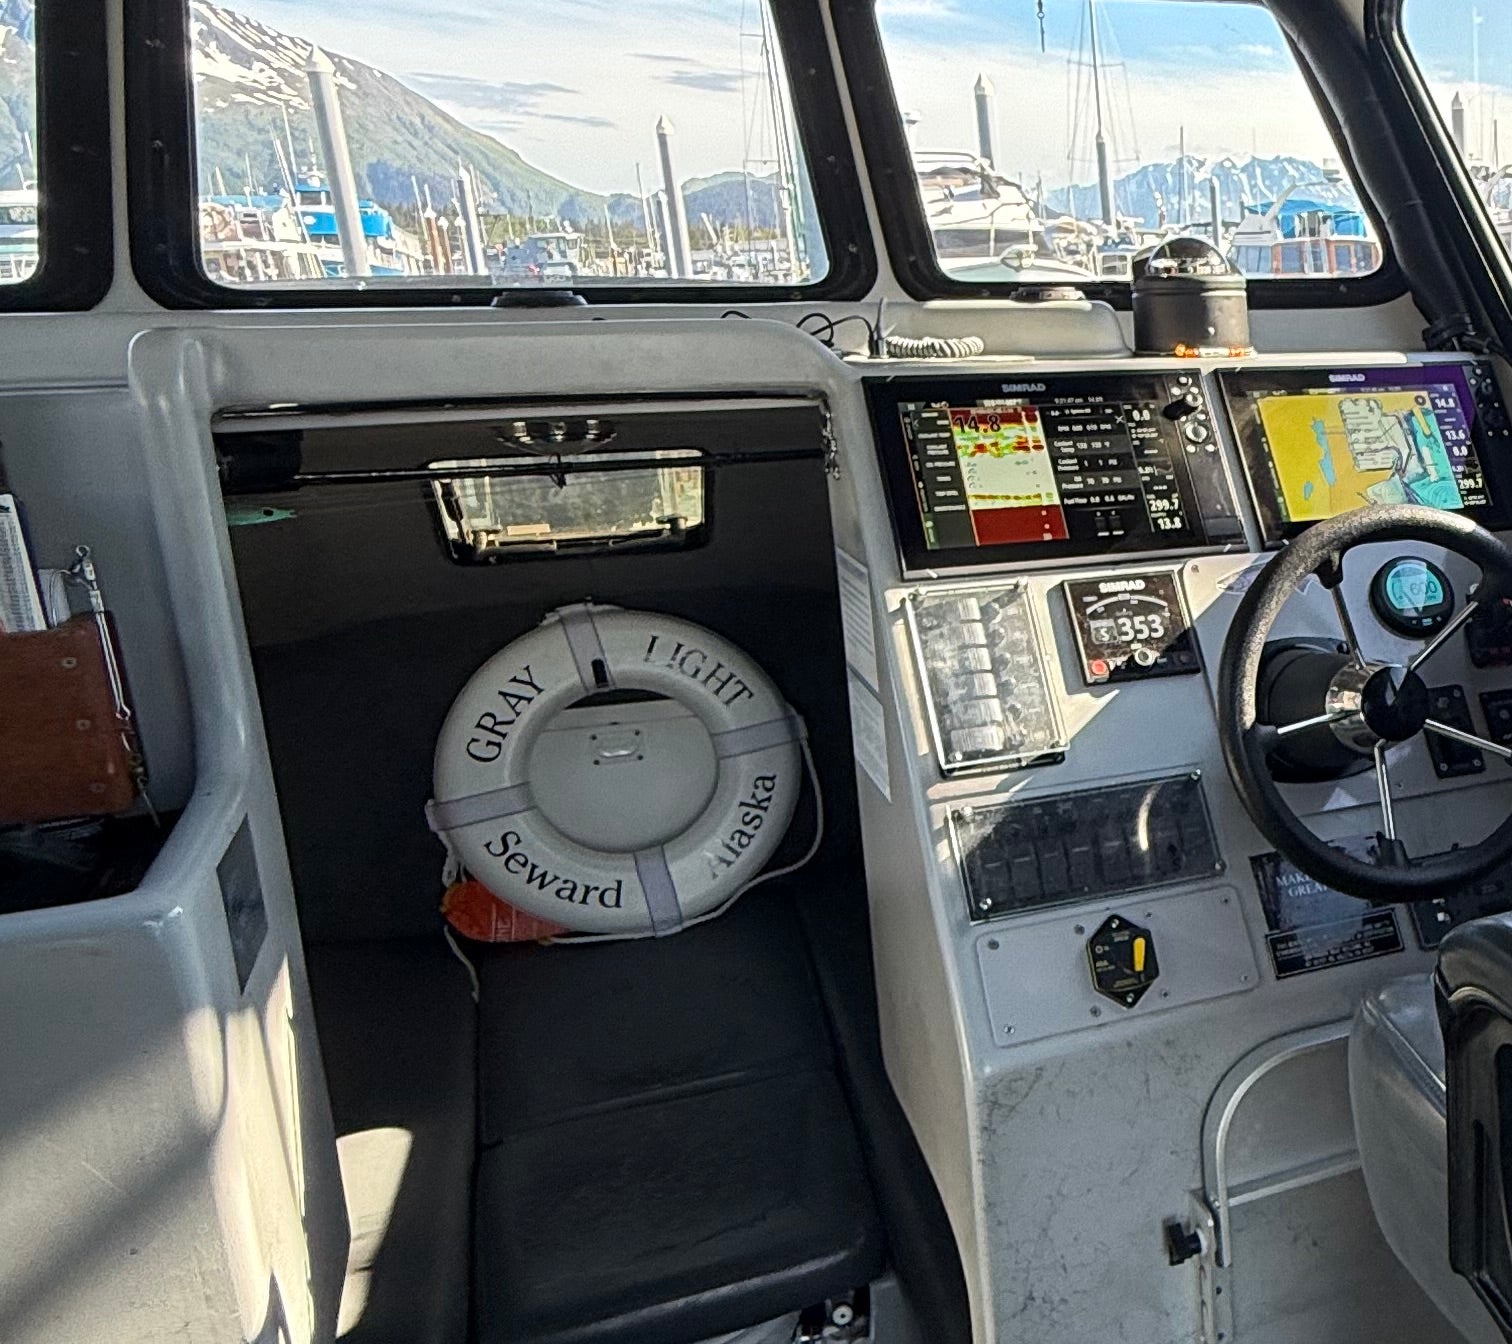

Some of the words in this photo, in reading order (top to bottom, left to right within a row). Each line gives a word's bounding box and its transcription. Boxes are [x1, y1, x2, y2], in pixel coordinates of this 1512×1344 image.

[1329, 373, 1365, 383] SIMRAD
[1001, 383, 1047, 393] SIMRAD
[1132, 409, 1150, 421] 0.0
[953, 414, 1001, 433] 14.8
[1149, 499, 1179, 511] 299.7
[1157, 517, 1182, 530] 13.8
[1098, 579, 1146, 593] SIMRAD
[1117, 614, 1165, 642] 353
[465, 665, 545, 764] GRAY
[643, 635, 755, 709] LIGHT
[483, 829, 624, 910] Seward
